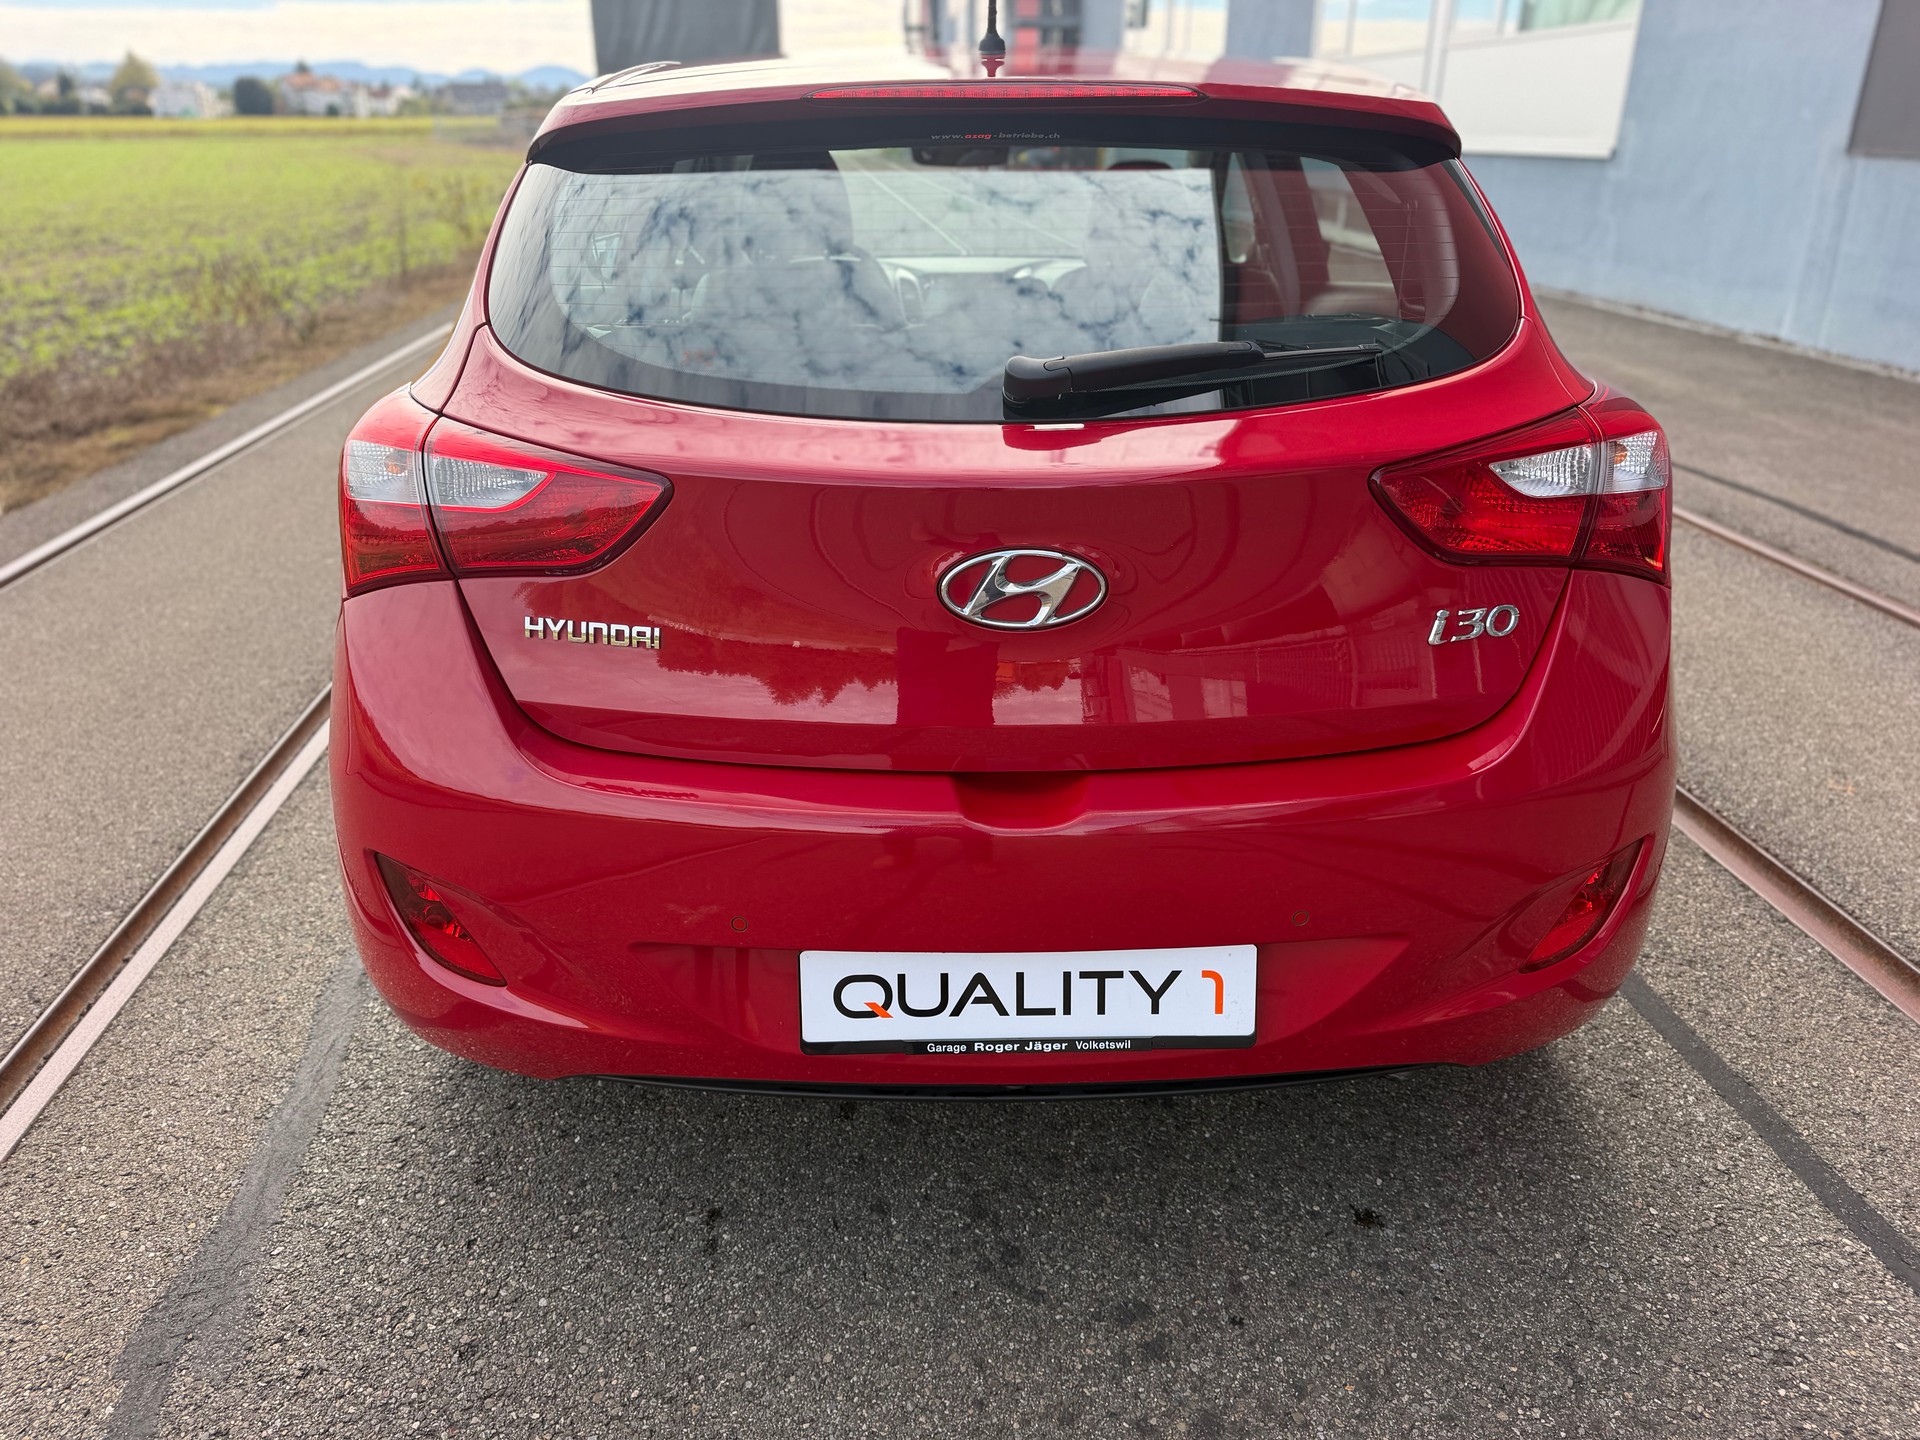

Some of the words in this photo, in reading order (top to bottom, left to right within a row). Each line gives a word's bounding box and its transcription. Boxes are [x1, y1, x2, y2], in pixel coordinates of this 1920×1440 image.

[931, 132, 1061, 140] www.azag-betriebe.ch
[524, 616, 661, 650] HYUNDAI
[1427, 604, 1520, 646] i30
[832, 969, 1183, 1020] QUALITY
[1201, 969, 1225, 1015] 1
[926, 1043, 967, 1054] Garage
[974, 1042, 1020, 1053] Roger
[1024, 1040, 1069, 1053] Jäger
[1075, 1039, 1132, 1051] Volketswil
